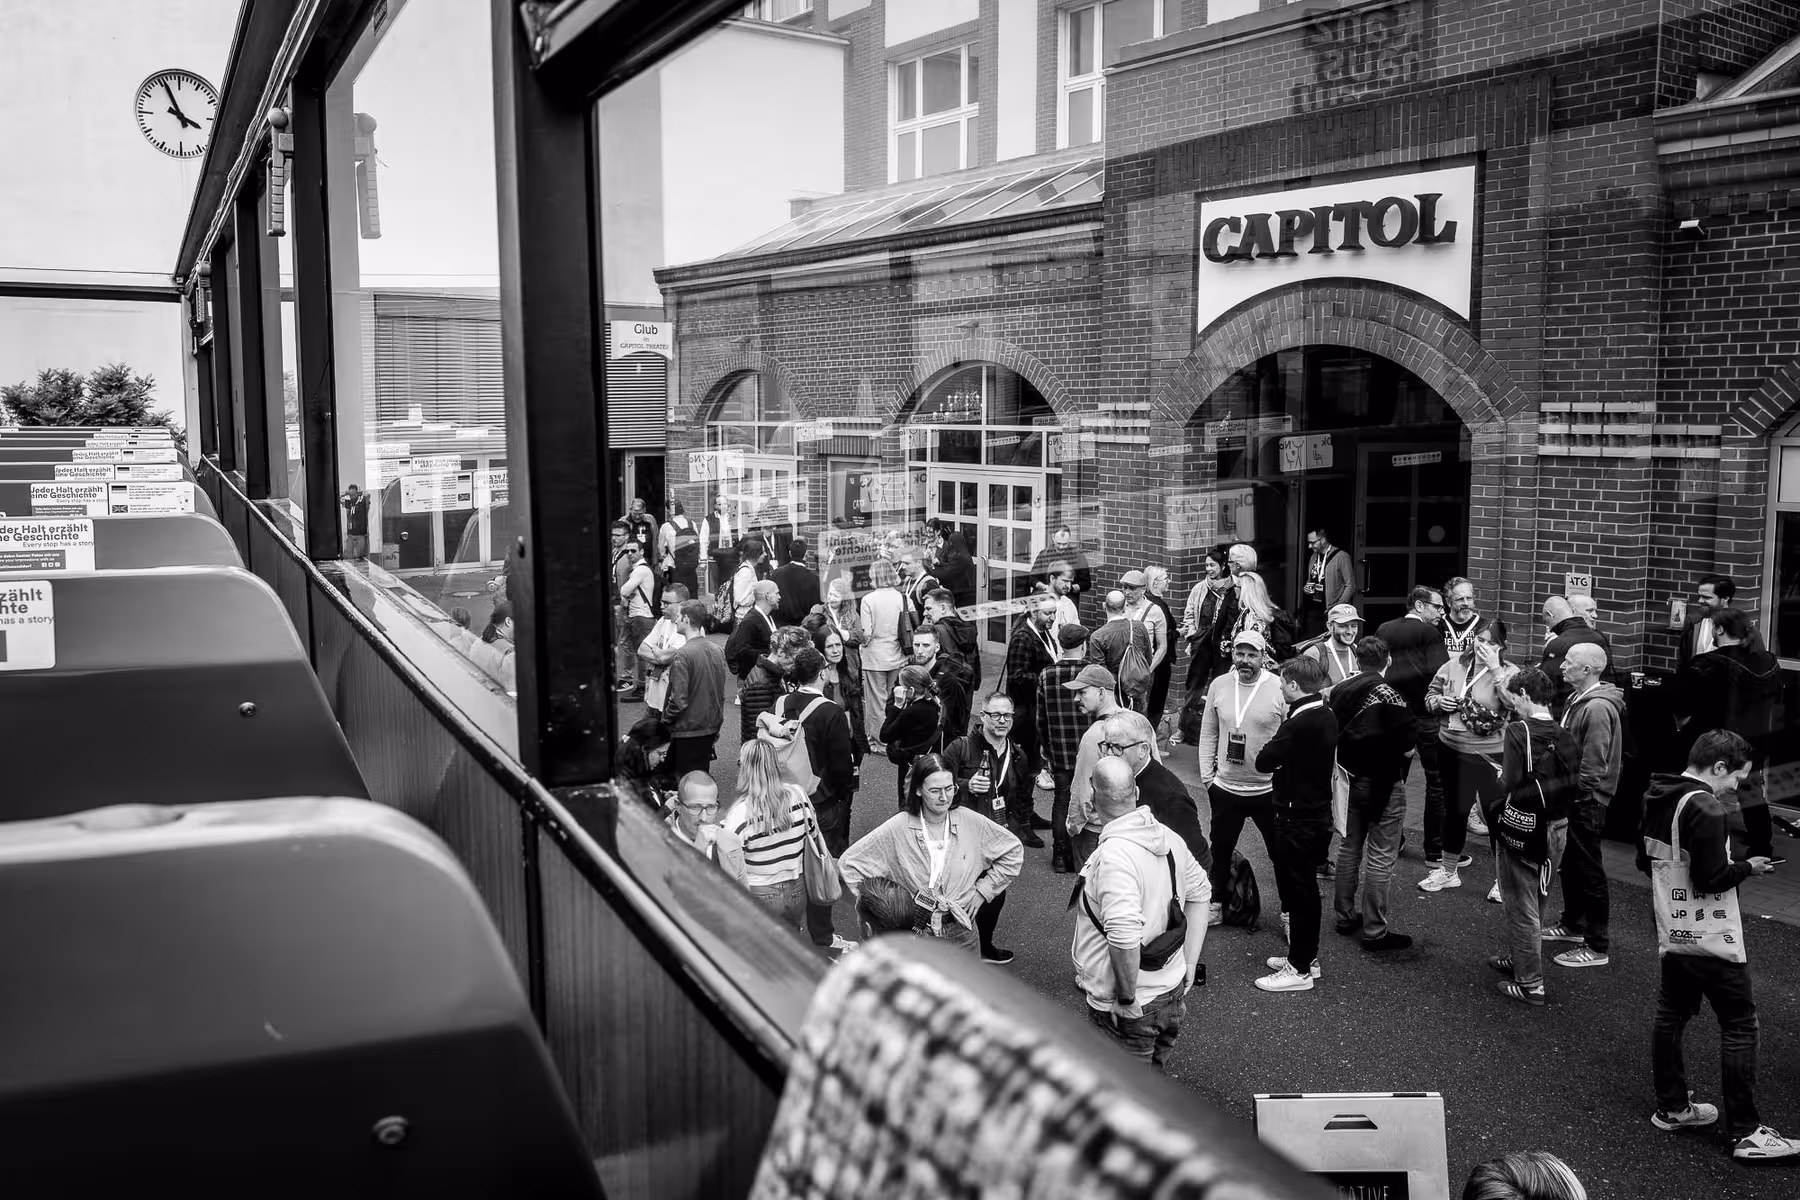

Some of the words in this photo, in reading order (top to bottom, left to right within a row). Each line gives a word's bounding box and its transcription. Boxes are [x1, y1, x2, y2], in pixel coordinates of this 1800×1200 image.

[1202, 192, 1458, 264] CAPITOL
[634, 323, 658, 335] Club
[22, 524, 45, 534] Halt
[49, 524, 88, 533] erzählt
[13, 532, 79, 542] Geschichte
[1569, 576, 1588, 586] ATG
[28, 616, 54, 624] story
[1670, 929, 1693, 938] 2025
